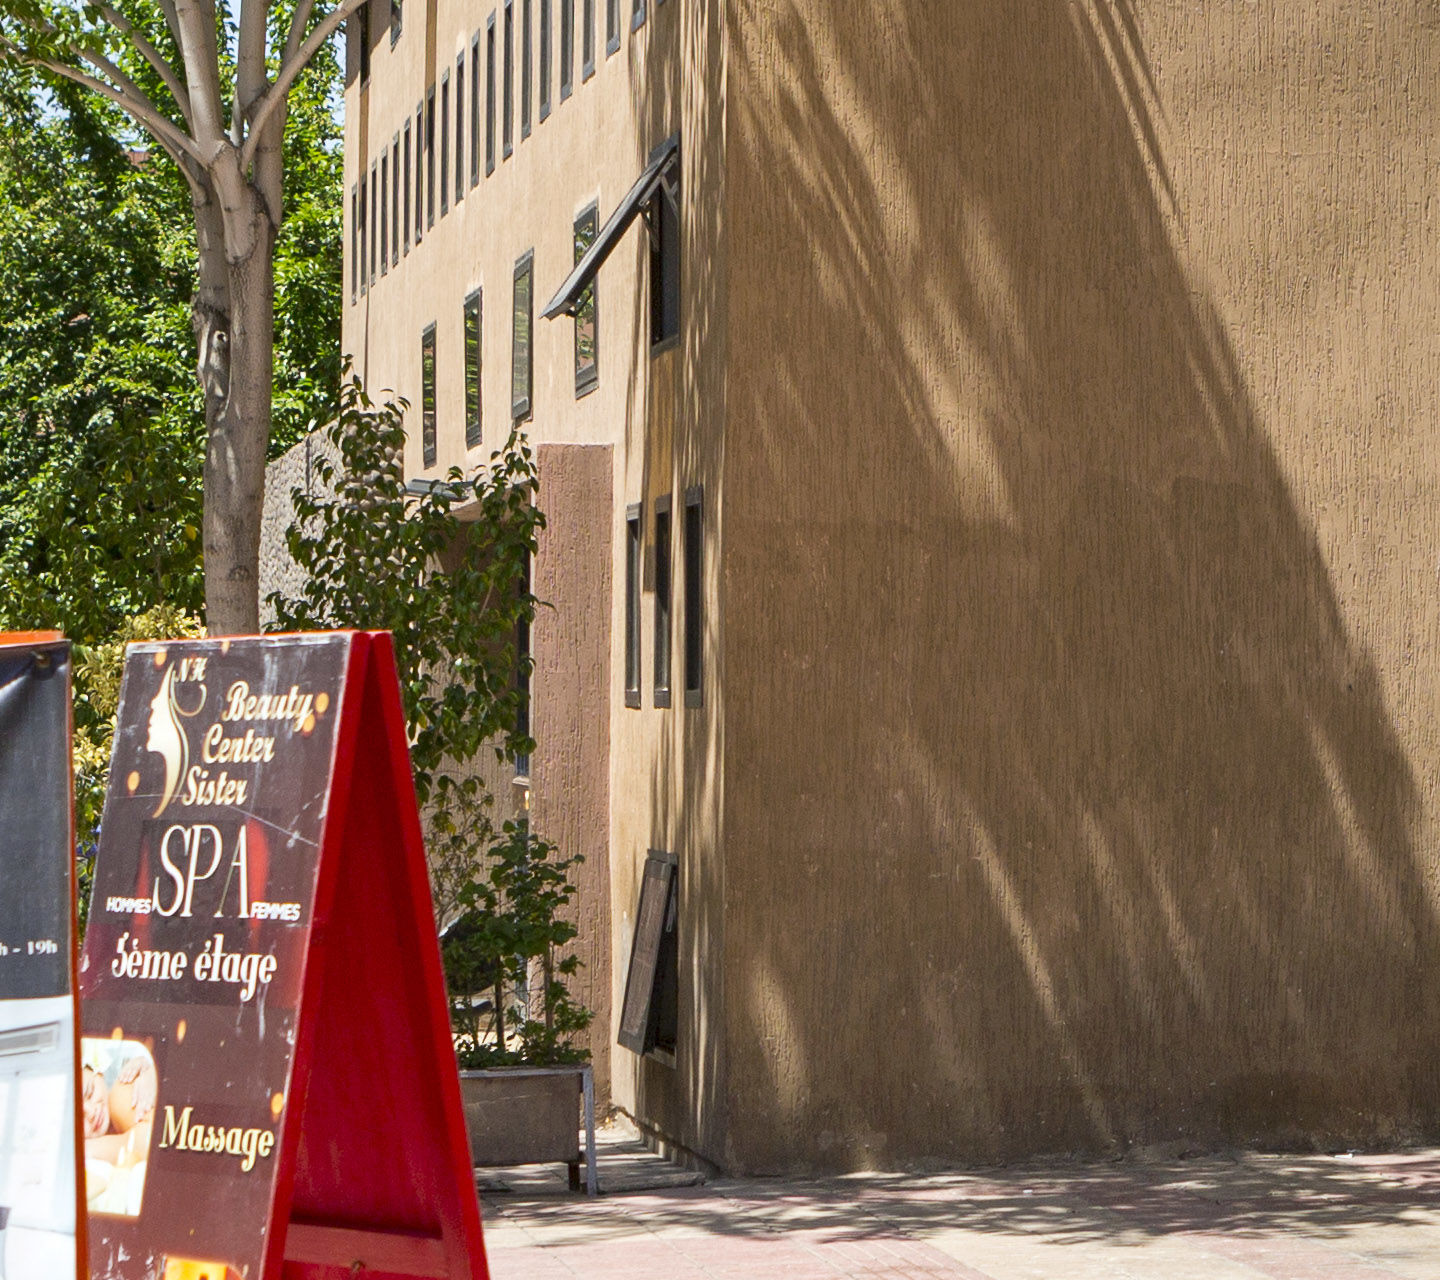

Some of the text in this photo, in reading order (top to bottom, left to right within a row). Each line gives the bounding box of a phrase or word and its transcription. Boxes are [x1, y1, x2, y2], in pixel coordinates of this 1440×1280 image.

[222, 681, 313, 732] Beauty
[202, 723, 275, 764] Center
[182, 765, 248, 807] Sister
[153, 824, 251, 919] SPA
[106, 897, 301, 921] HOMMES FEMMES
[27, 940, 57, 955] 19h
[194, 933, 277, 1002] étage
[159, 1105, 275, 1172] Massage
